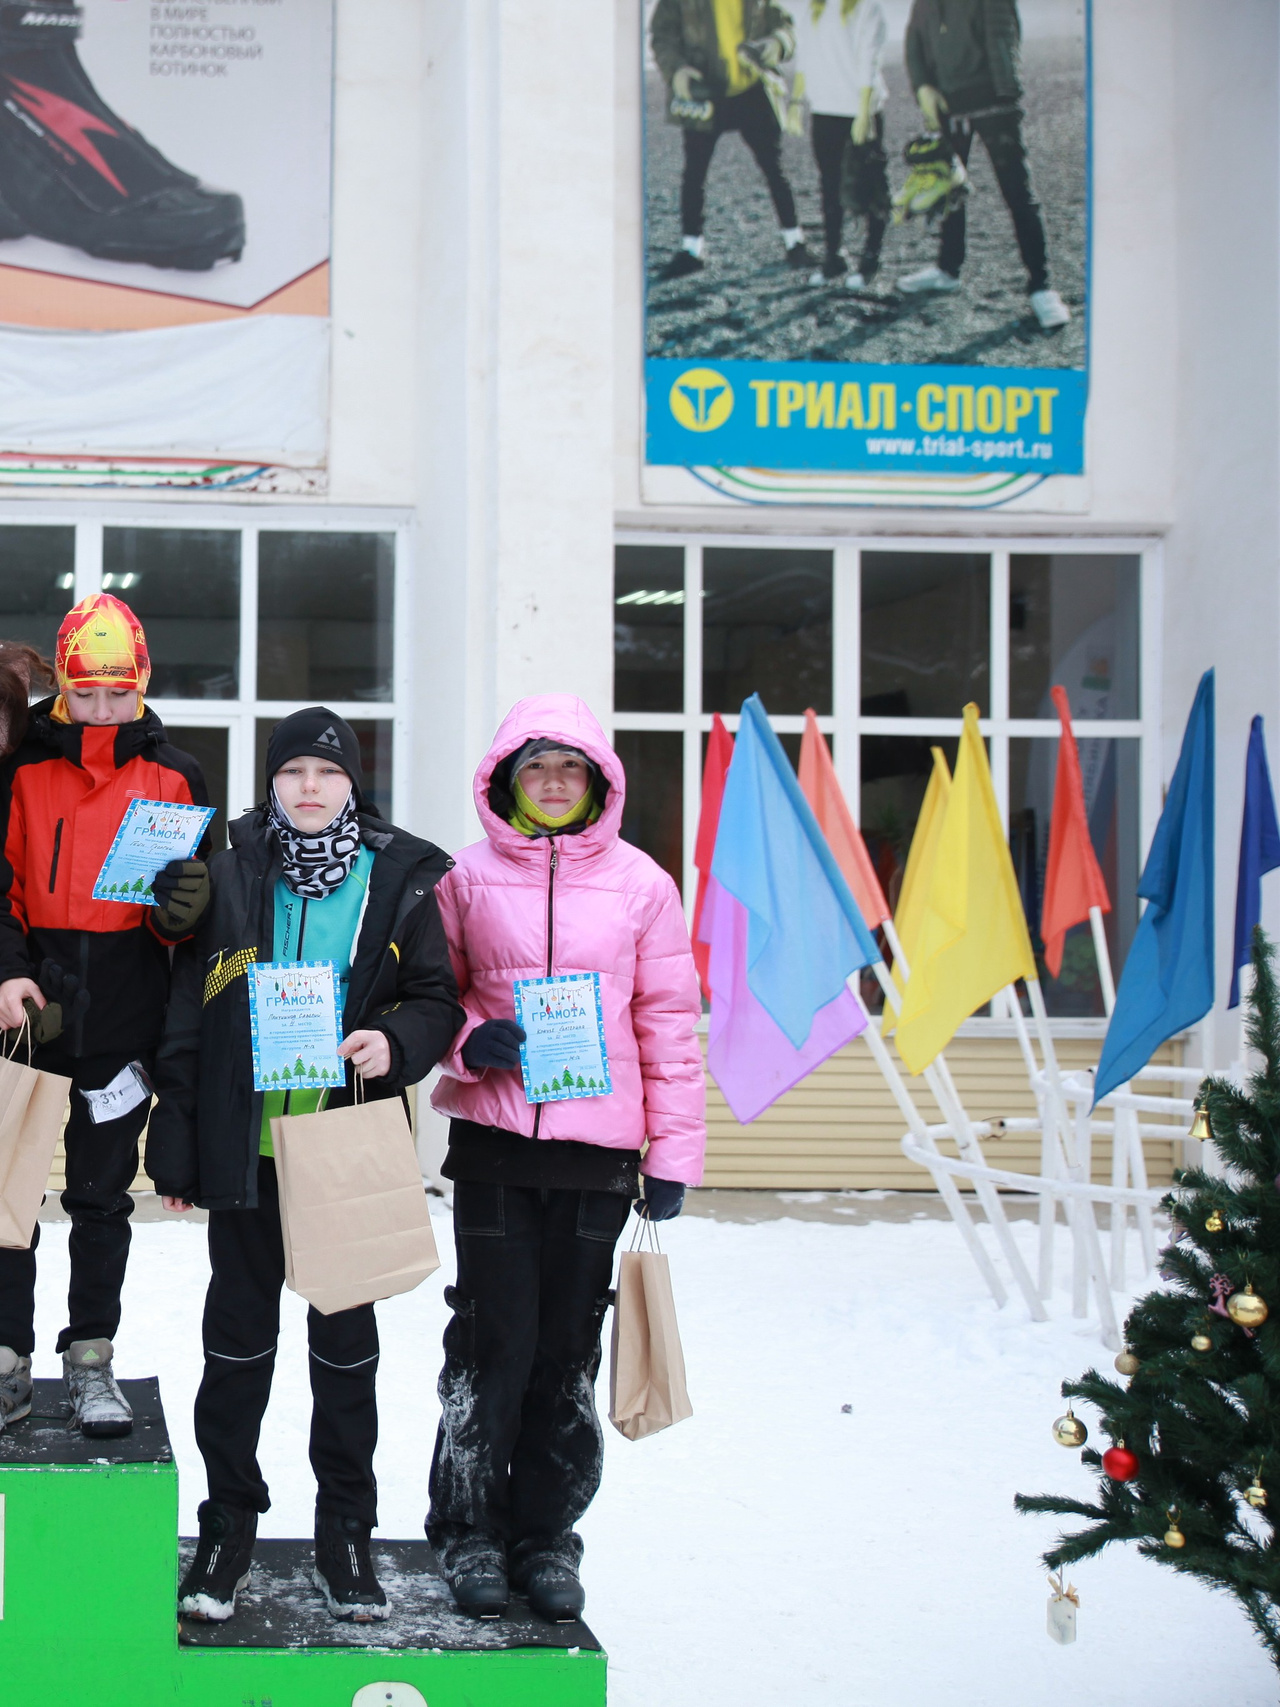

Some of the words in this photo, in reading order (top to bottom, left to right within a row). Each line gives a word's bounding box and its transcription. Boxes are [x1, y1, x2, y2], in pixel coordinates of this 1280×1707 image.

[164, 8, 208, 22] МИРЕ
[150, 25, 256, 42] ПОЛНОСТЬЮ
[150, 43, 264, 60] КАРБОНОВЫЙ
[150, 61, 228, 78] БОТИНОК
[866, 436, 1052, 460] www.trial-sport.ru
[312, 742, 343, 754] FISCHER
[134, 826, 186, 840] ГРАМОТА
[283, 912, 292, 958] FISCHER
[266, 995, 324, 1006] ГРАМОТА
[531, 1007, 586, 1021] ГРАМОТА
